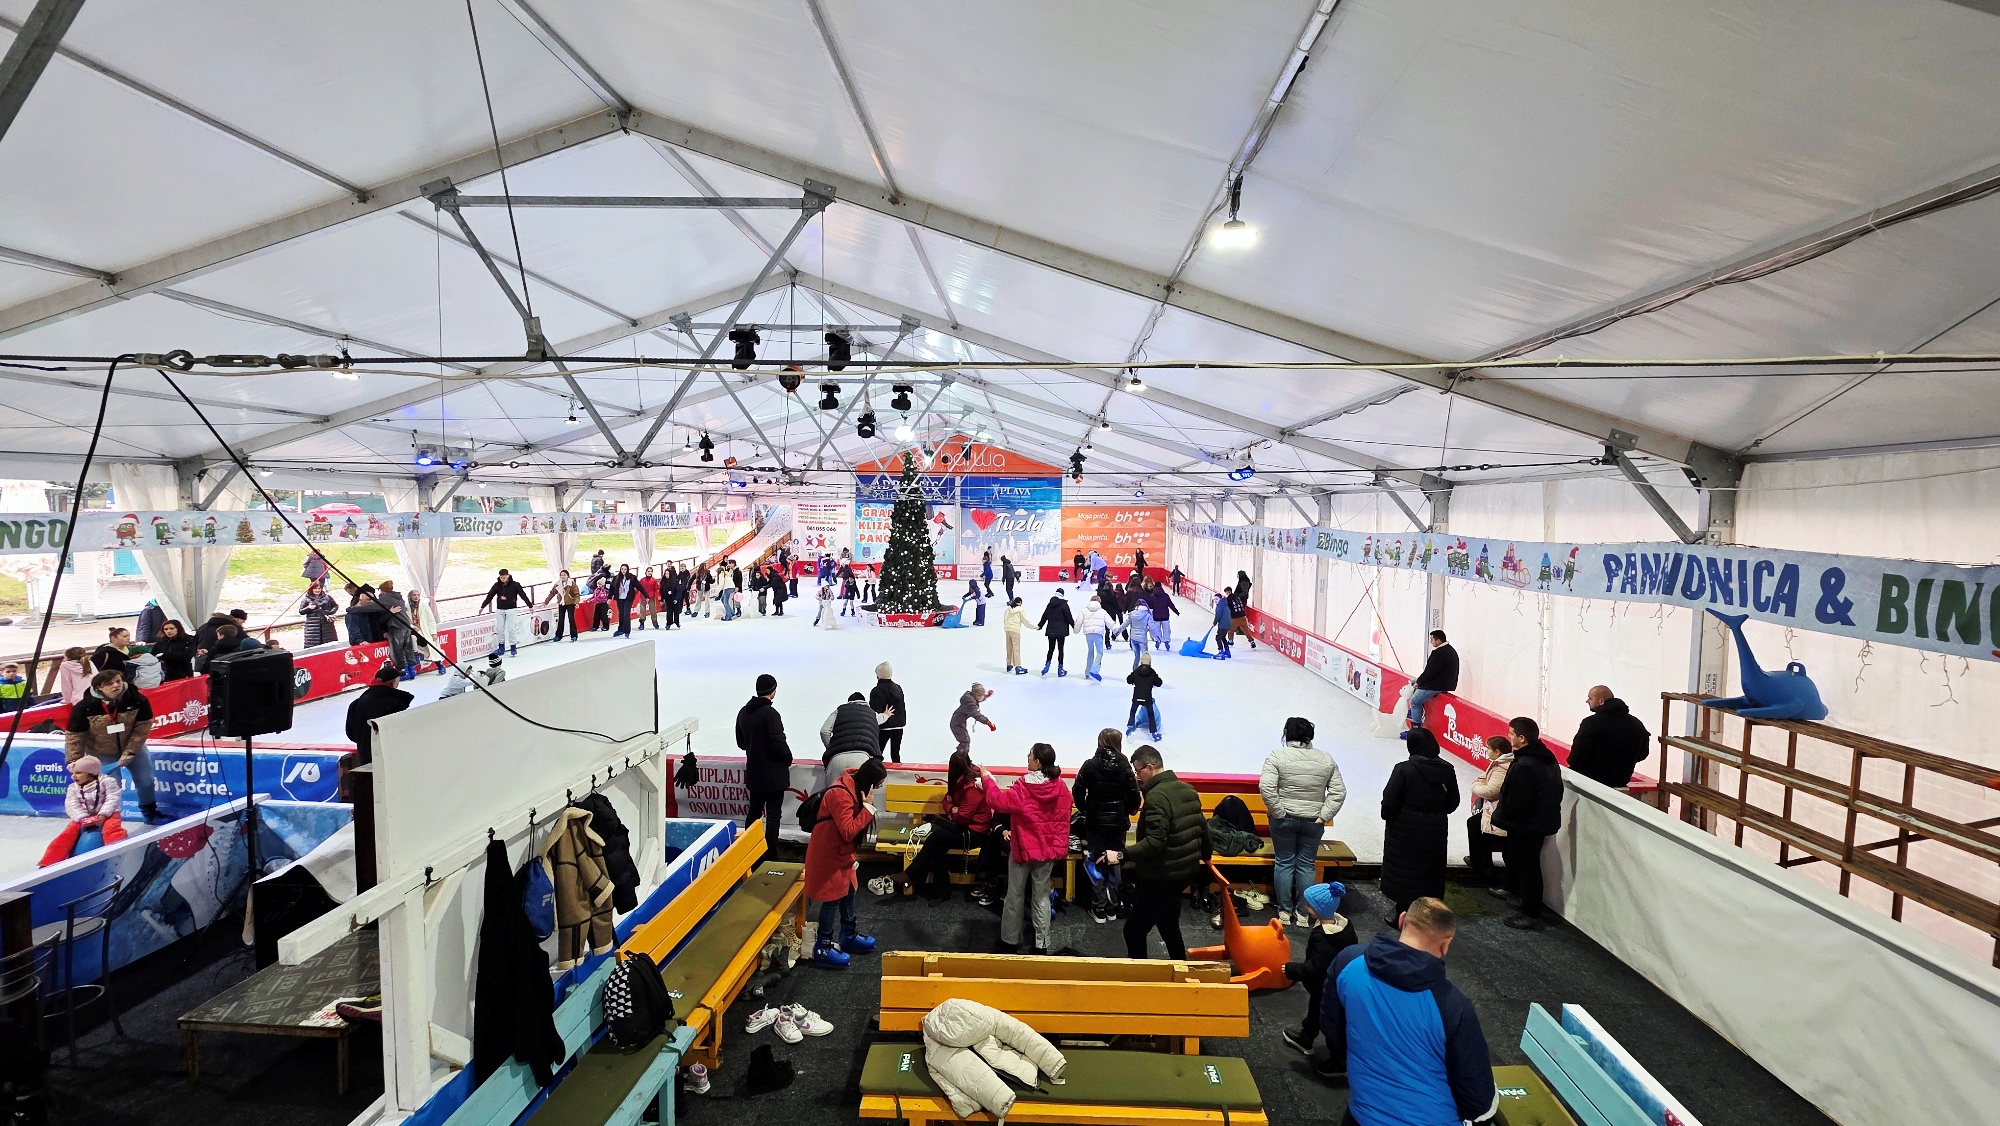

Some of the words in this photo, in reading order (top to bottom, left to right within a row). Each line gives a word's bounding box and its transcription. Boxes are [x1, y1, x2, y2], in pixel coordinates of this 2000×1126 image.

[1000, 487, 1031, 496] PLAVA
[863, 508, 894, 518] GRAD
[464, 516, 503, 536] Bingo
[995, 513, 1045, 533] Tuzla
[0, 519, 69, 549] NGO
[1326, 532, 1349, 558] Bingo
[1815, 566, 1857, 627] &
[1875, 572, 2000, 650] BIN
[374, 646, 390, 658] OSVO
[1443, 703, 1490, 760] Pannon
[34, 763, 63, 773] gratis
[155, 757, 219, 776] magija
[29, 774, 55, 784] KAFA
[697, 767, 741, 785] UPLJAJ
[22, 784, 66, 795] PALAČINK
[175, 778, 233, 796] počne.
[687, 785, 720, 800] ISPOD
[722, 784, 751, 801] ČEPA
[689, 801, 728, 815] OSVOJI
[315, 967, 354, 980] PERI
[901, 1053, 911, 1071] PAN
[1206, 1065, 1220, 1083] PAN
[1498, 1088, 1527, 1096] PAN
